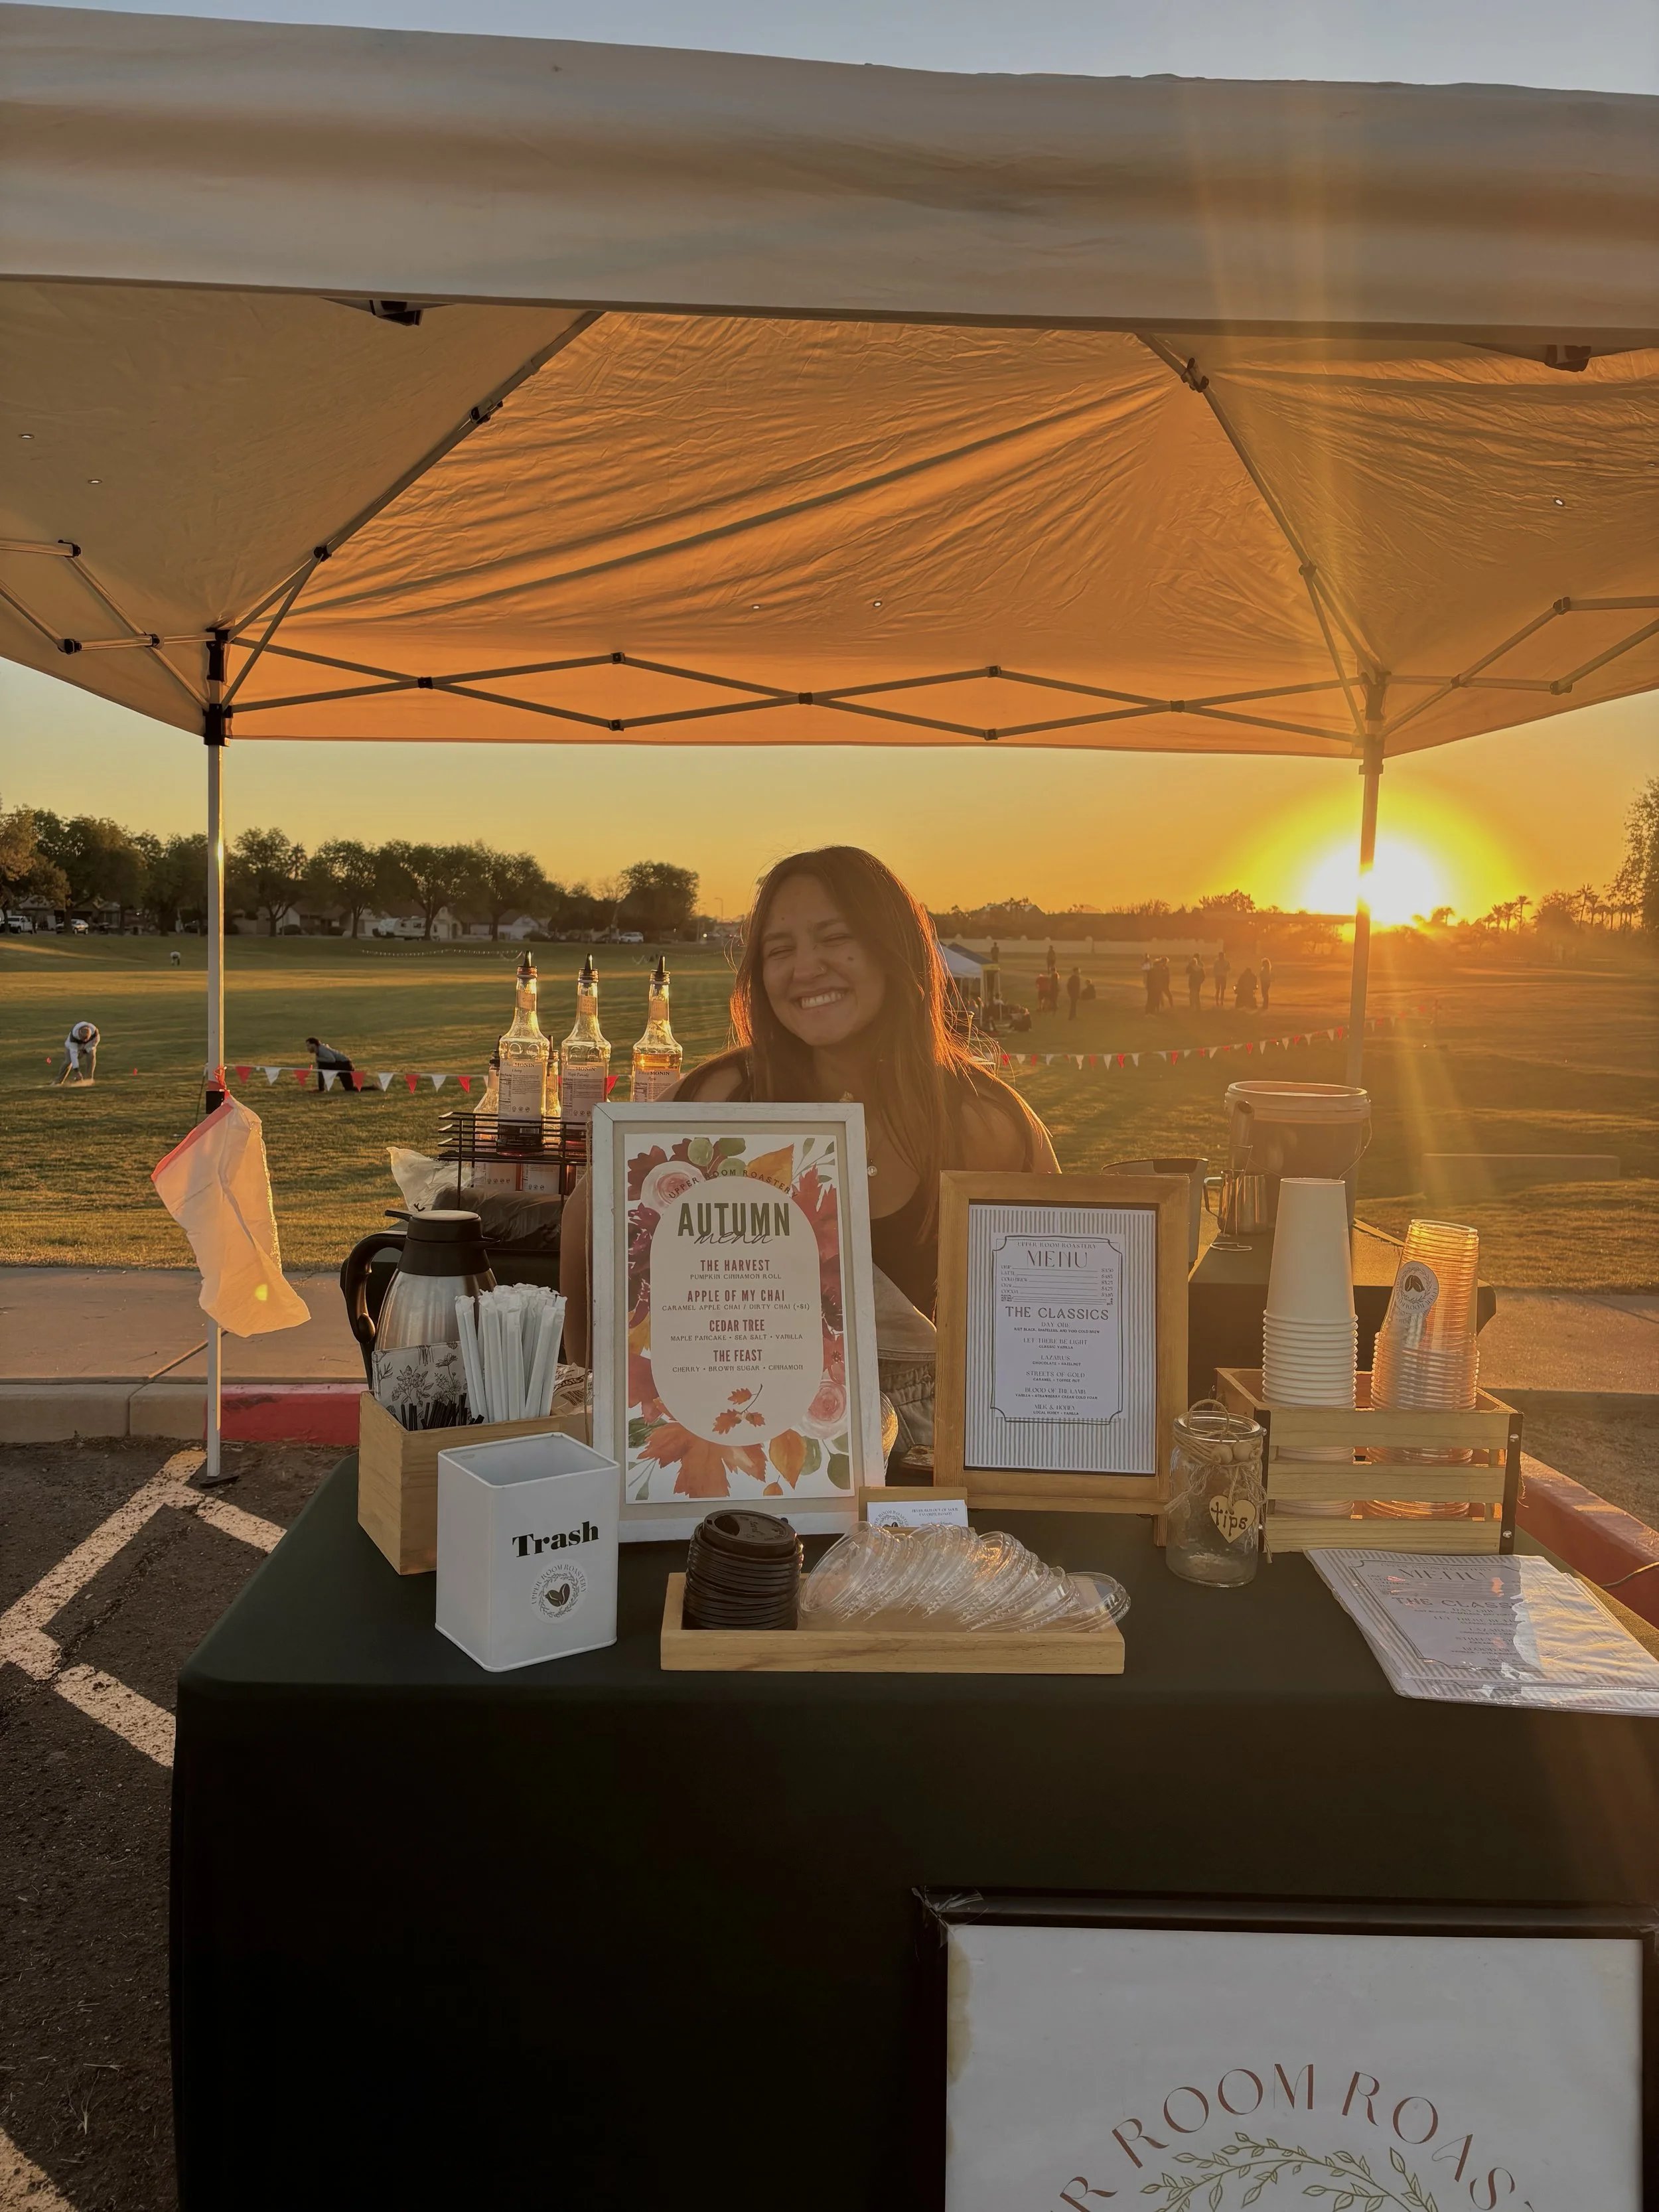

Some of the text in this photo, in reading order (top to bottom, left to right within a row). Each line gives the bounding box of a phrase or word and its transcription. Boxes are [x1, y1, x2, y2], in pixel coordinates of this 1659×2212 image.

[668, 1169, 798, 1199] UPPER ROOM ROASTERY
[678, 1203, 790, 1236] AUTUMN
[694, 1231, 773, 1244] menu
[701, 1259, 770, 1272] THE HARVEST
[1027, 1250, 1087, 1268] MENU
[687, 1290, 785, 1302] APPLE OF MY CHAI
[1005, 1306, 1109, 1321] THE CLASSICS
[709, 1319, 765, 1331] CEDAR TREE
[713, 1349, 762, 1362] THE FEAST
[1210, 1502, 1248, 1537] tips
[512, 1521, 599, 1558] Trash
[1112, 2063, 1315, 2169] ROOM
[1342, 2071, 1534, 2212] ROAS
